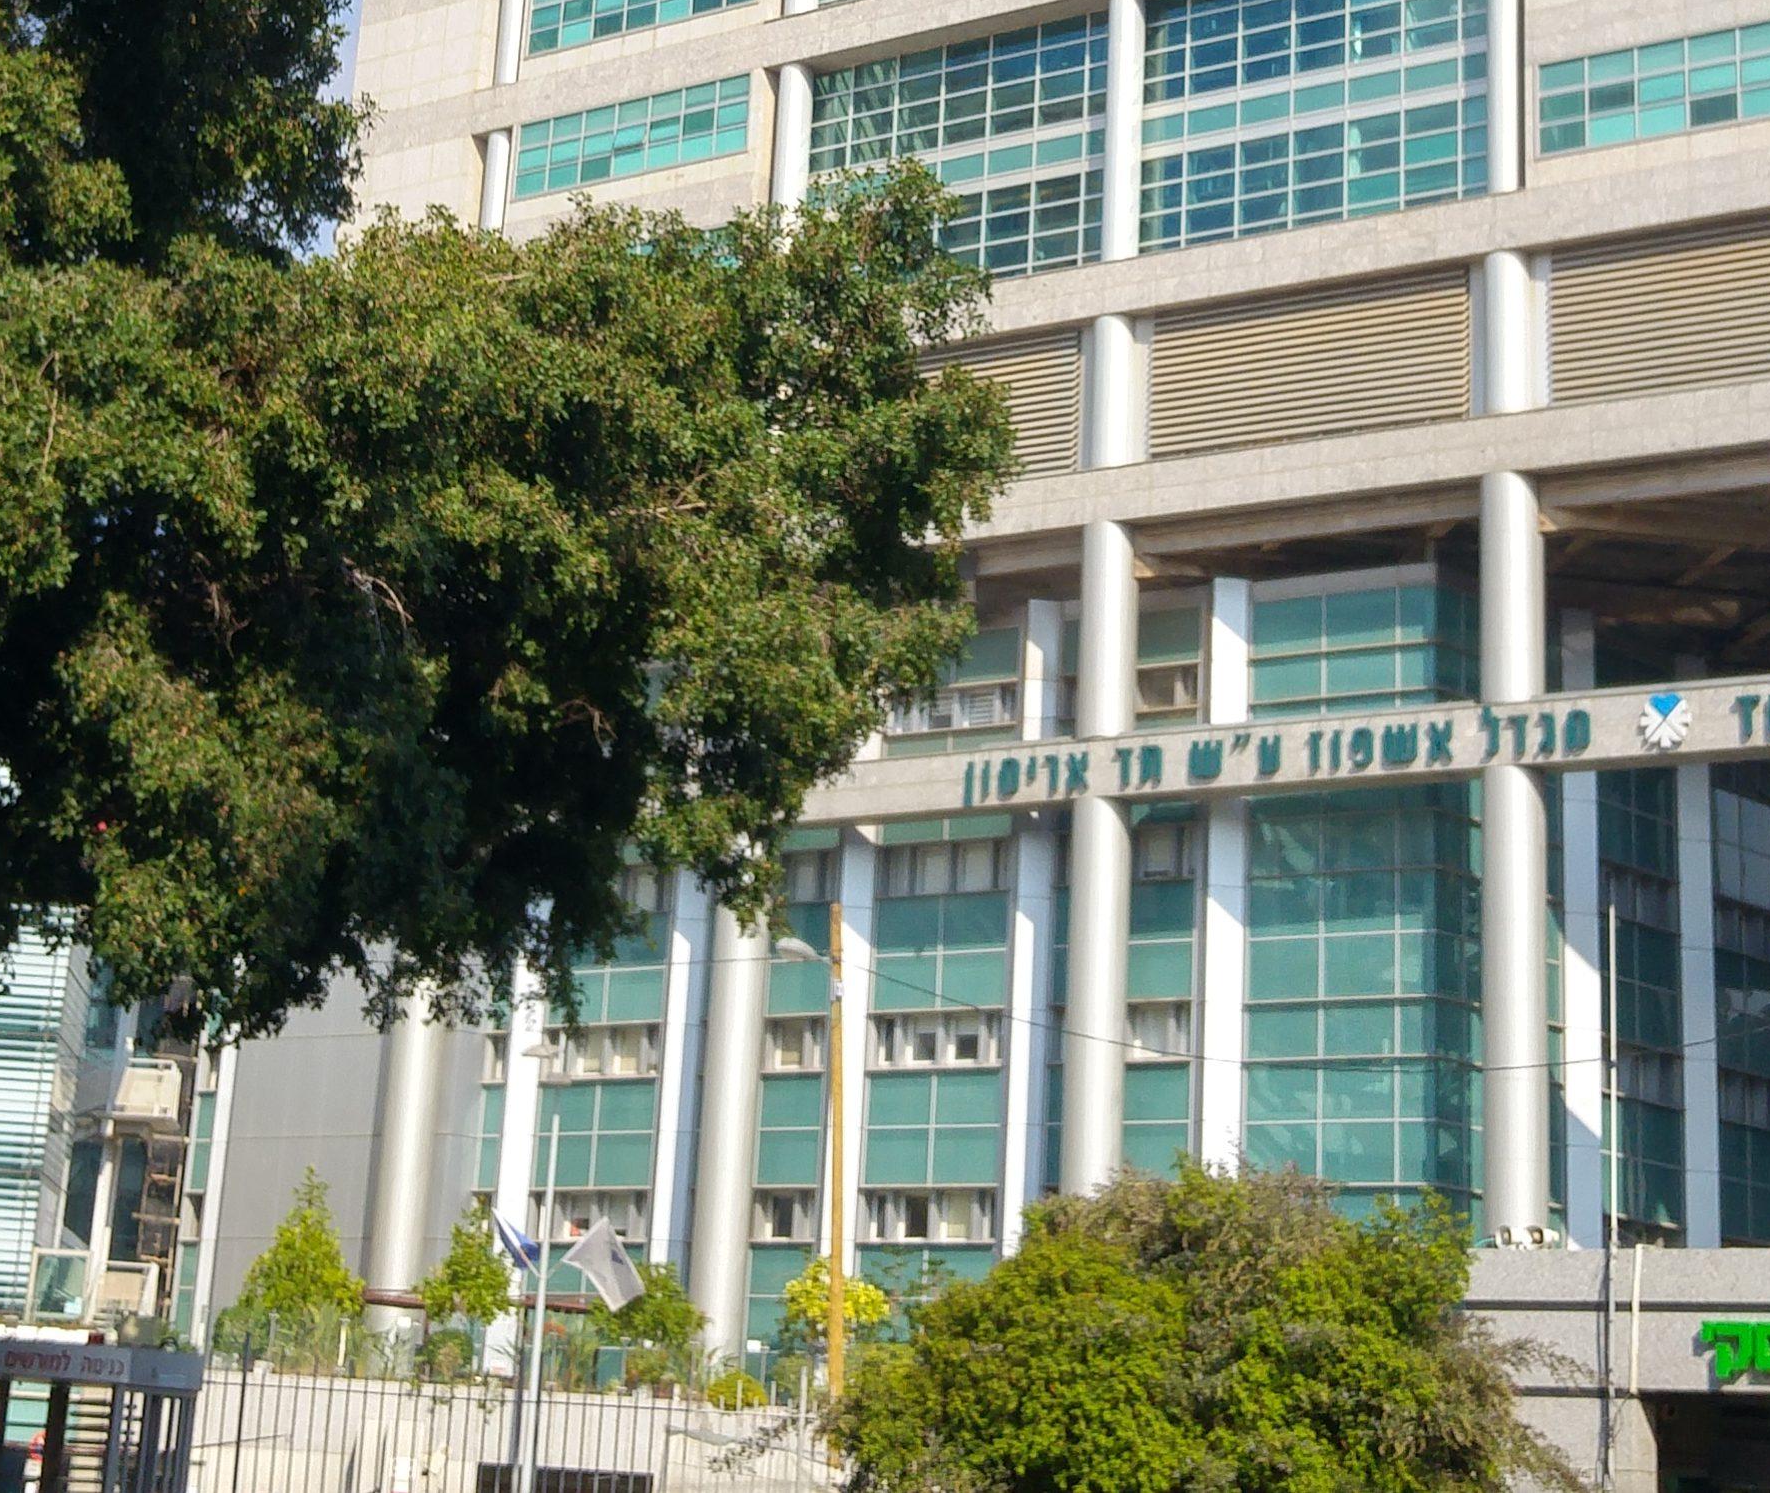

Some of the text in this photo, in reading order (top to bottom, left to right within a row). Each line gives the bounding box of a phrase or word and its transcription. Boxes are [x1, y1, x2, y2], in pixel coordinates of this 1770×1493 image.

[1308, 718, 1453, 776] אשפוז
[1481, 706, 1591, 760] מגדל
[963, 752, 1088, 806] אריסון
[80, 1354, 126, 1376] כניסה
